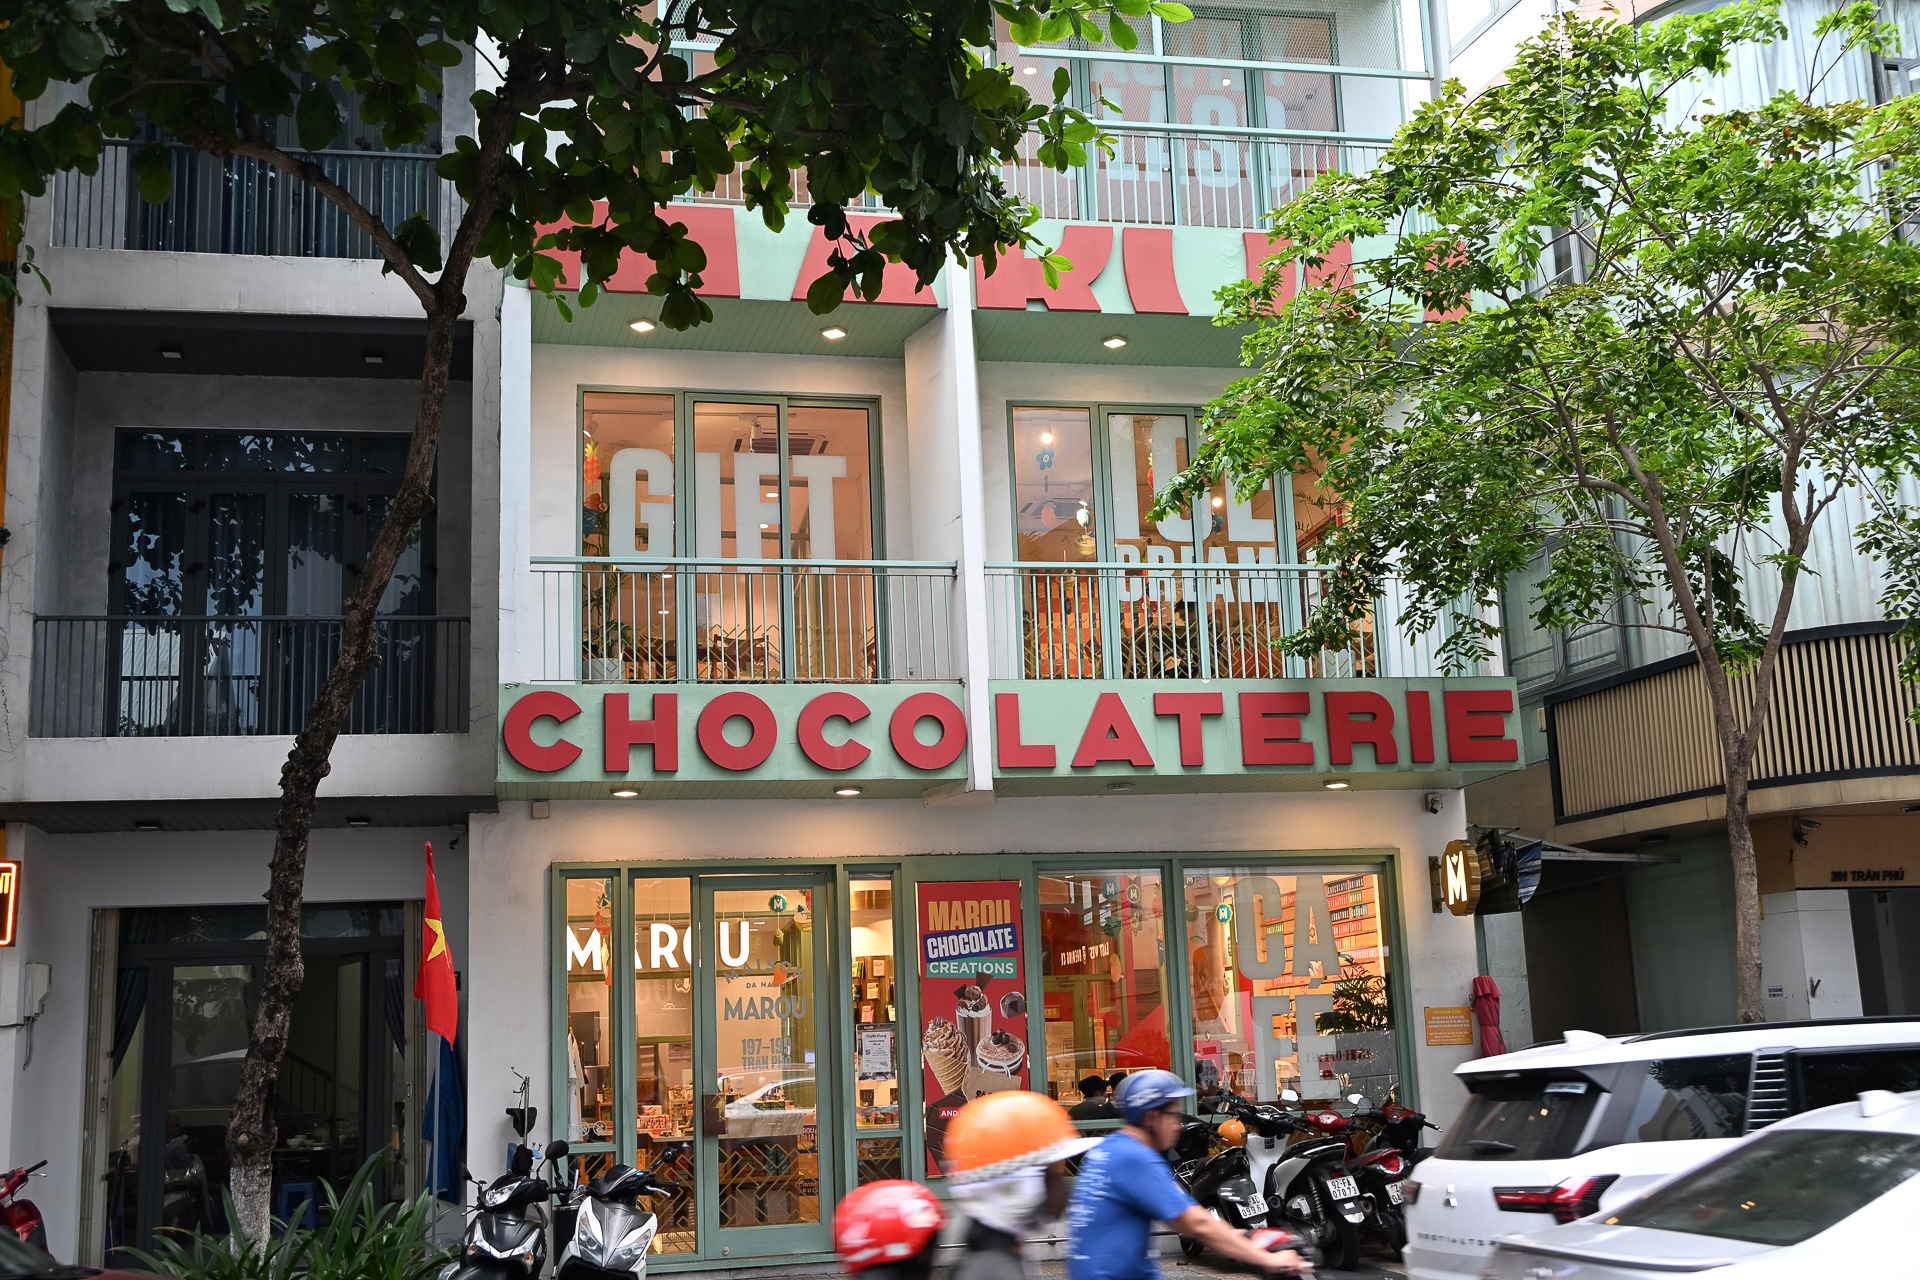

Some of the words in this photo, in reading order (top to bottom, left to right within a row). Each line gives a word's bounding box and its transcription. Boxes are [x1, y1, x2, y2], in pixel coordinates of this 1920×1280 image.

[609, 447, 847, 573] GIFT
[504, 690, 1518, 772] CHOCOLATERIE
[1445, 850, 1468, 906] M
[928, 899, 1011, 931] MAROU
[567, 921, 749, 971] MRU
[926, 928, 1014, 959] CHOCOLATE
[723, 958, 806, 984] MAISON
[929, 961, 1014, 974] CREATIONS
[723, 995, 807, 1021] MAROU
[1331, 1178, 1352, 1191] 92-FA
